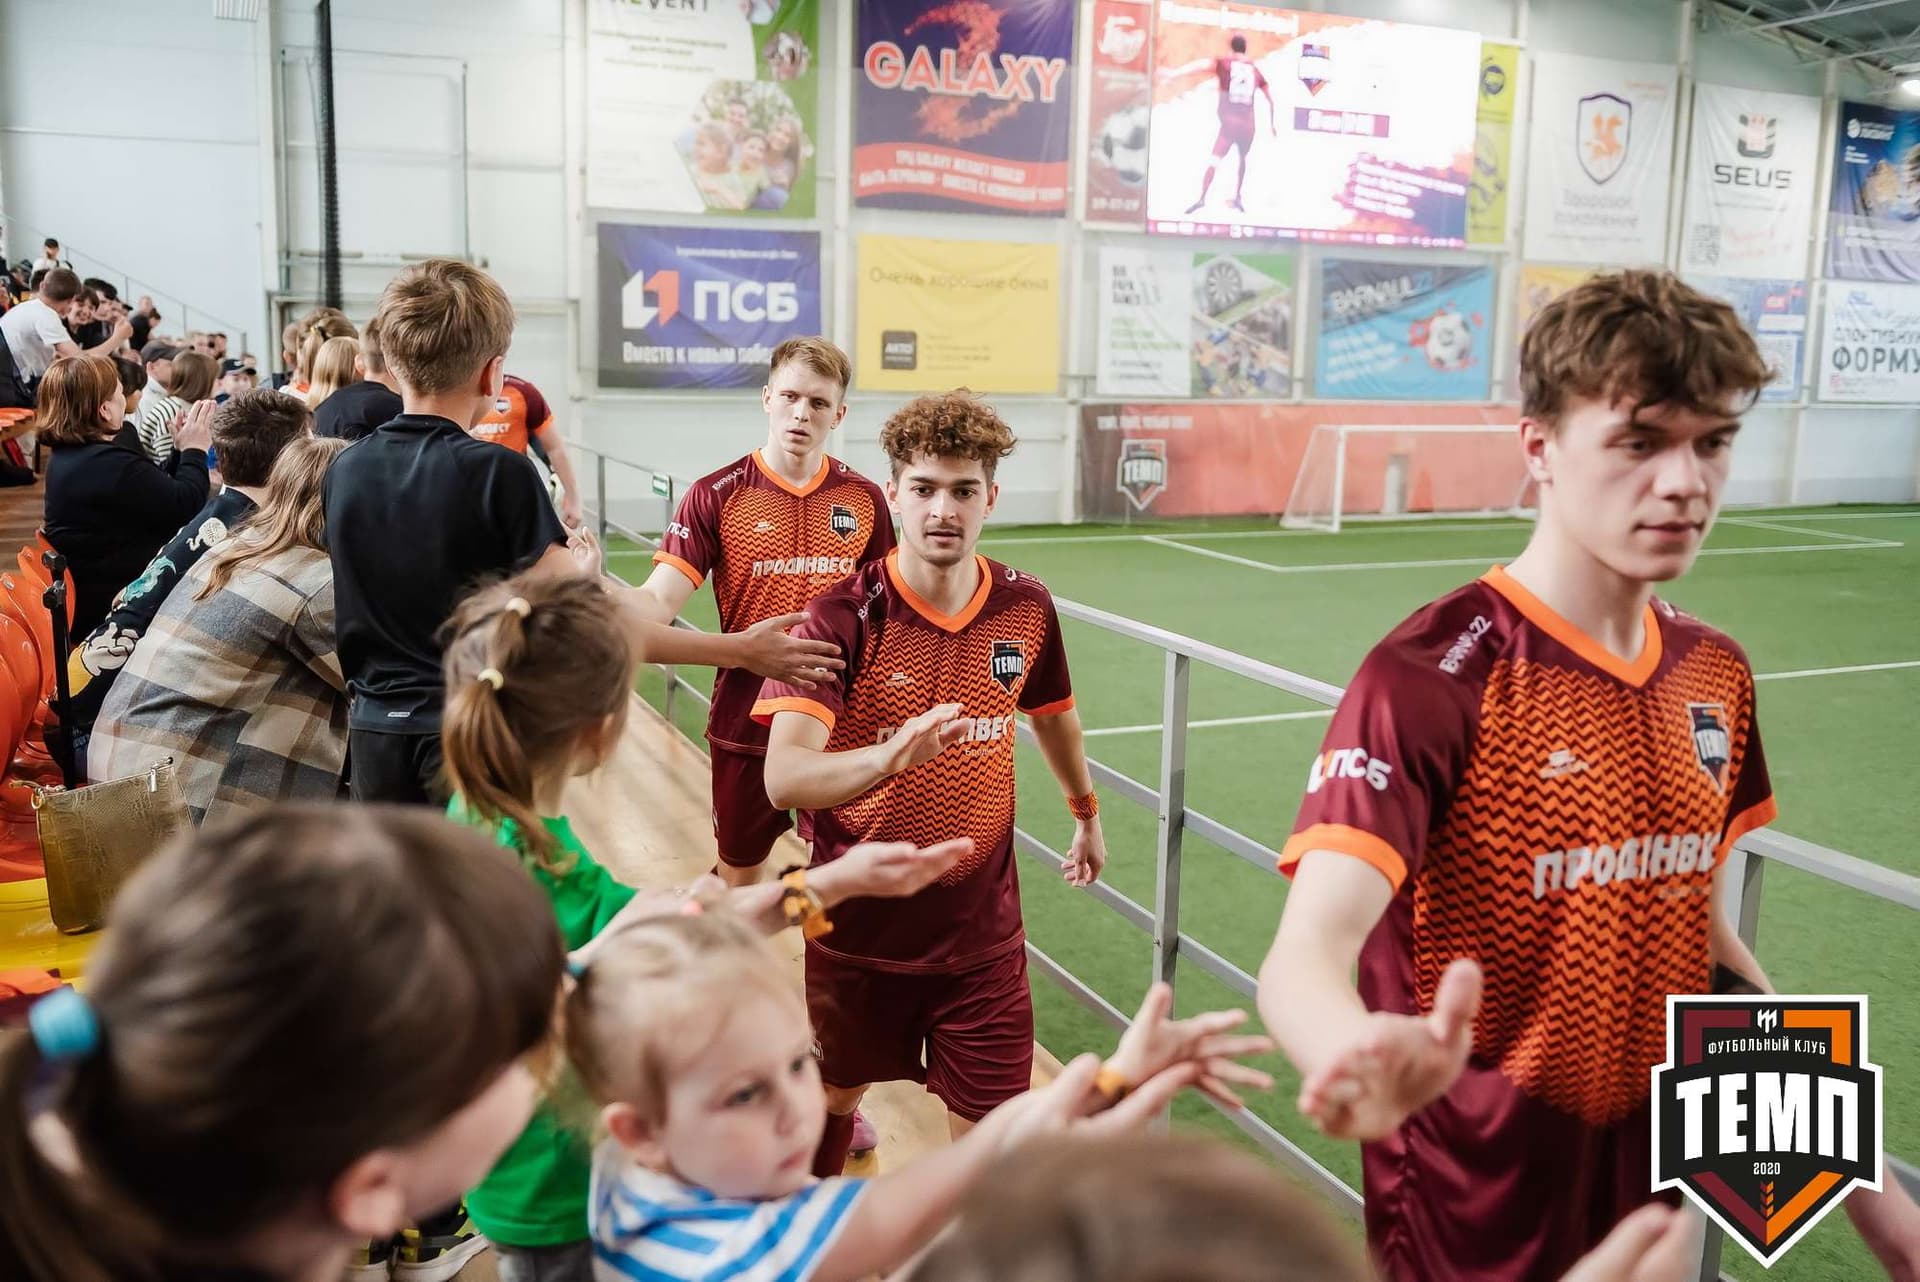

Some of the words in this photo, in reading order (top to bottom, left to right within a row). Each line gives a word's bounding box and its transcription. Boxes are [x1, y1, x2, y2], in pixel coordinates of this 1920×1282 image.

[864, 41, 1066, 103] GALAXY
[1714, 164, 1792, 189] SEUS
[694, 280, 799, 322] ПСБ
[667, 521, 690, 540] ПСБ
[833, 515, 856, 530] ТЕМП
[994, 655, 1022, 675] ТЕМП
[1326, 747, 1393, 791] ПСБ
